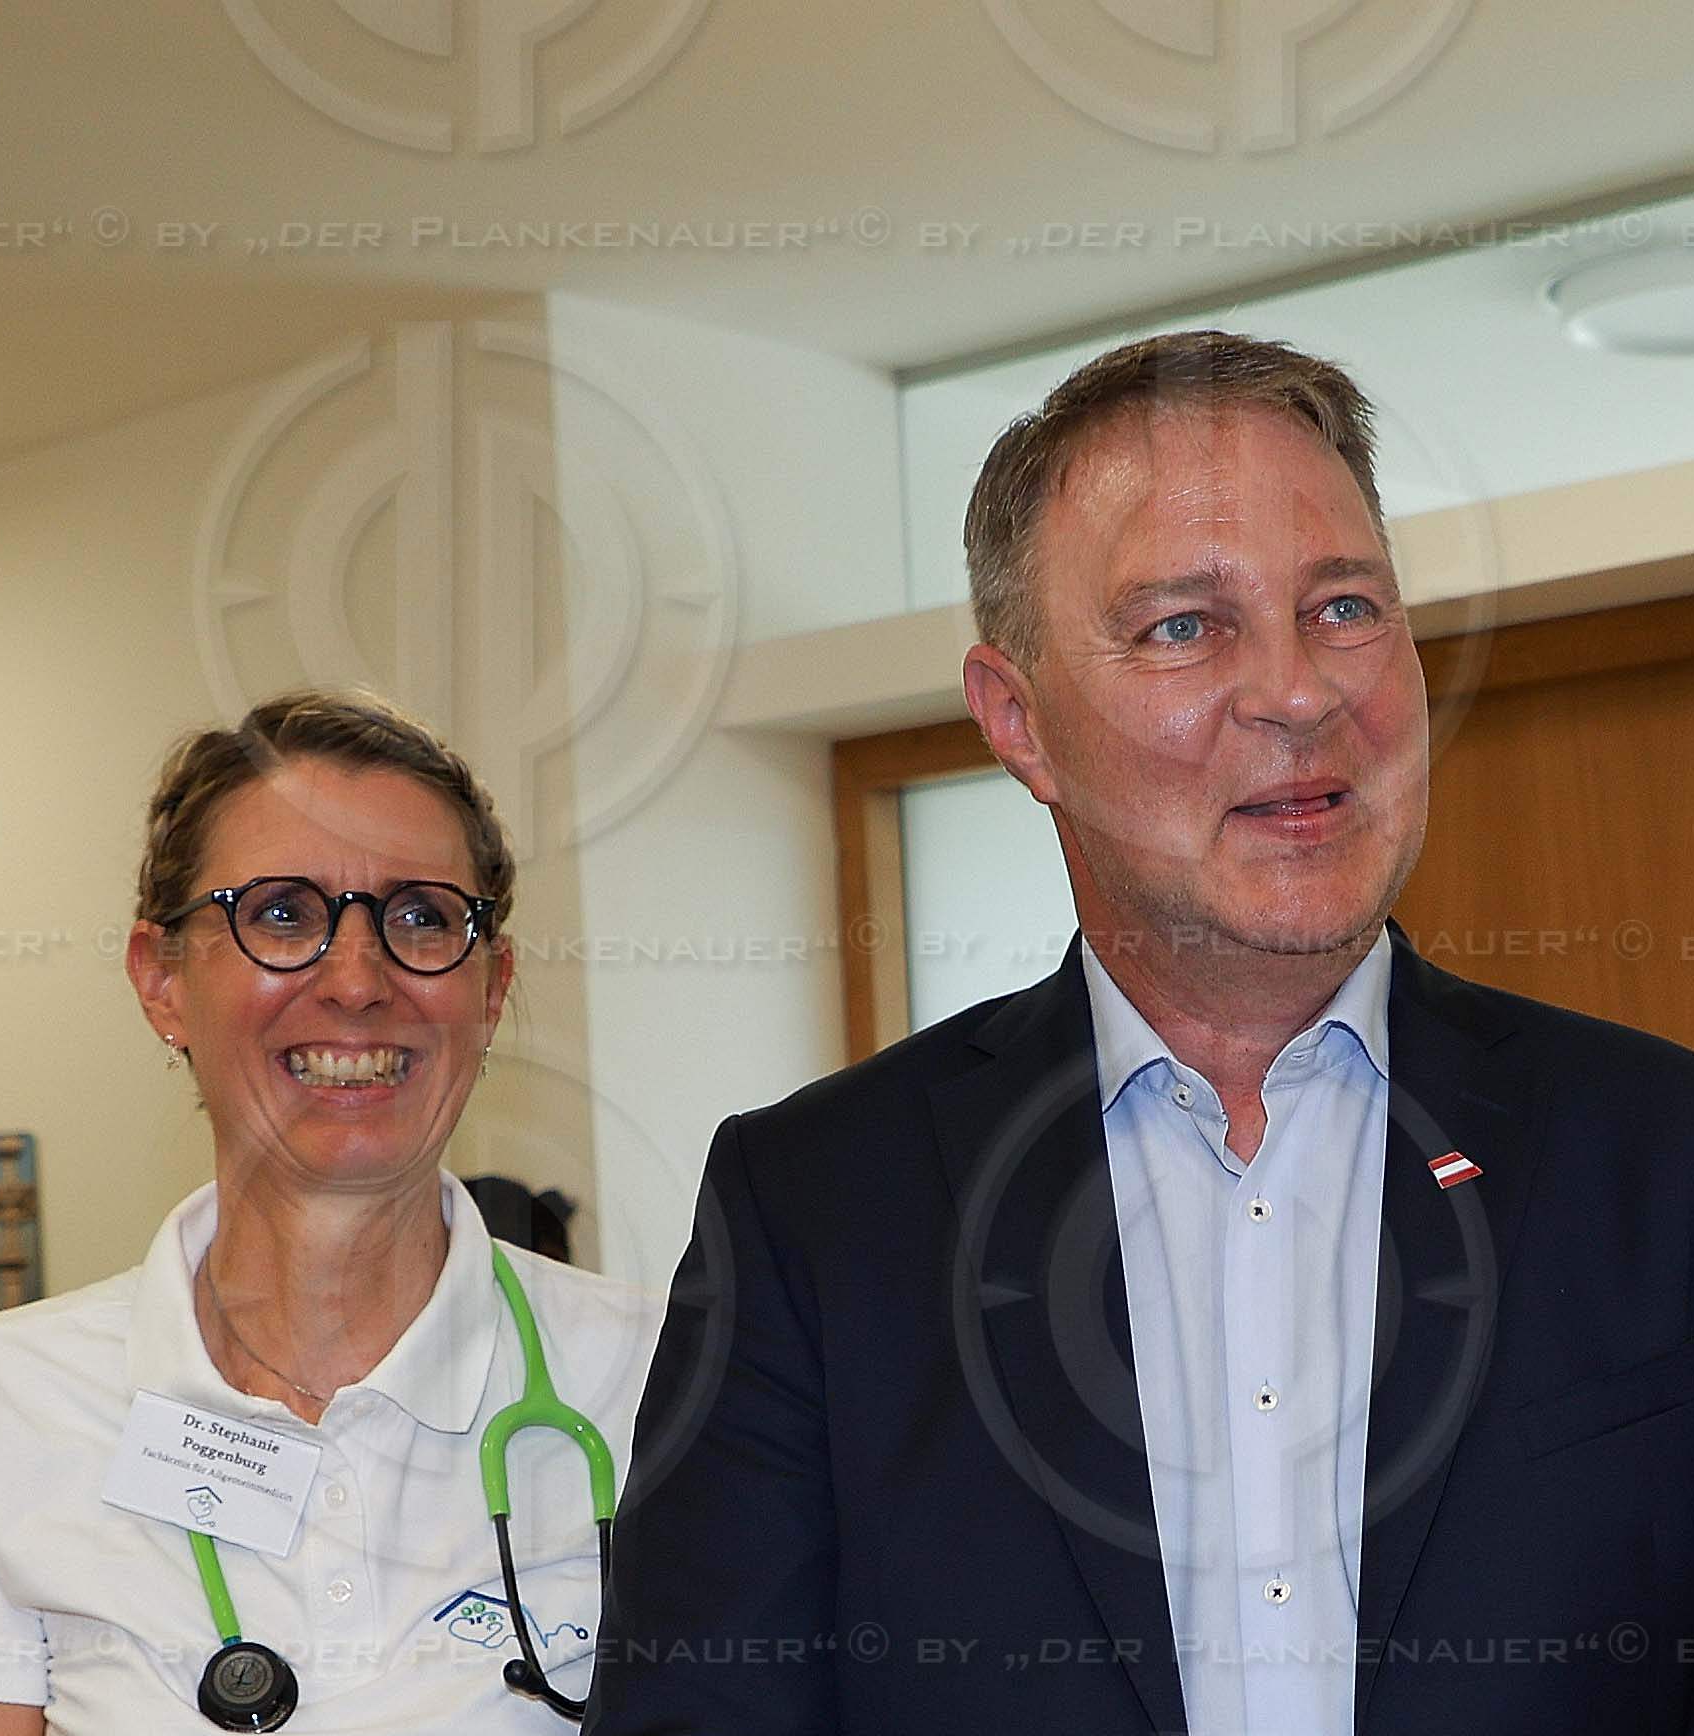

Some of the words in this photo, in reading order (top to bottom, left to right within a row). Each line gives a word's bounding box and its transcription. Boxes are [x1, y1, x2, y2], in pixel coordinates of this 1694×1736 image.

[183, 1414, 205, 1431] Dr.
[209, 1422, 281, 1455] Stephanie
[181, 1436, 268, 1477] Poggenburg
